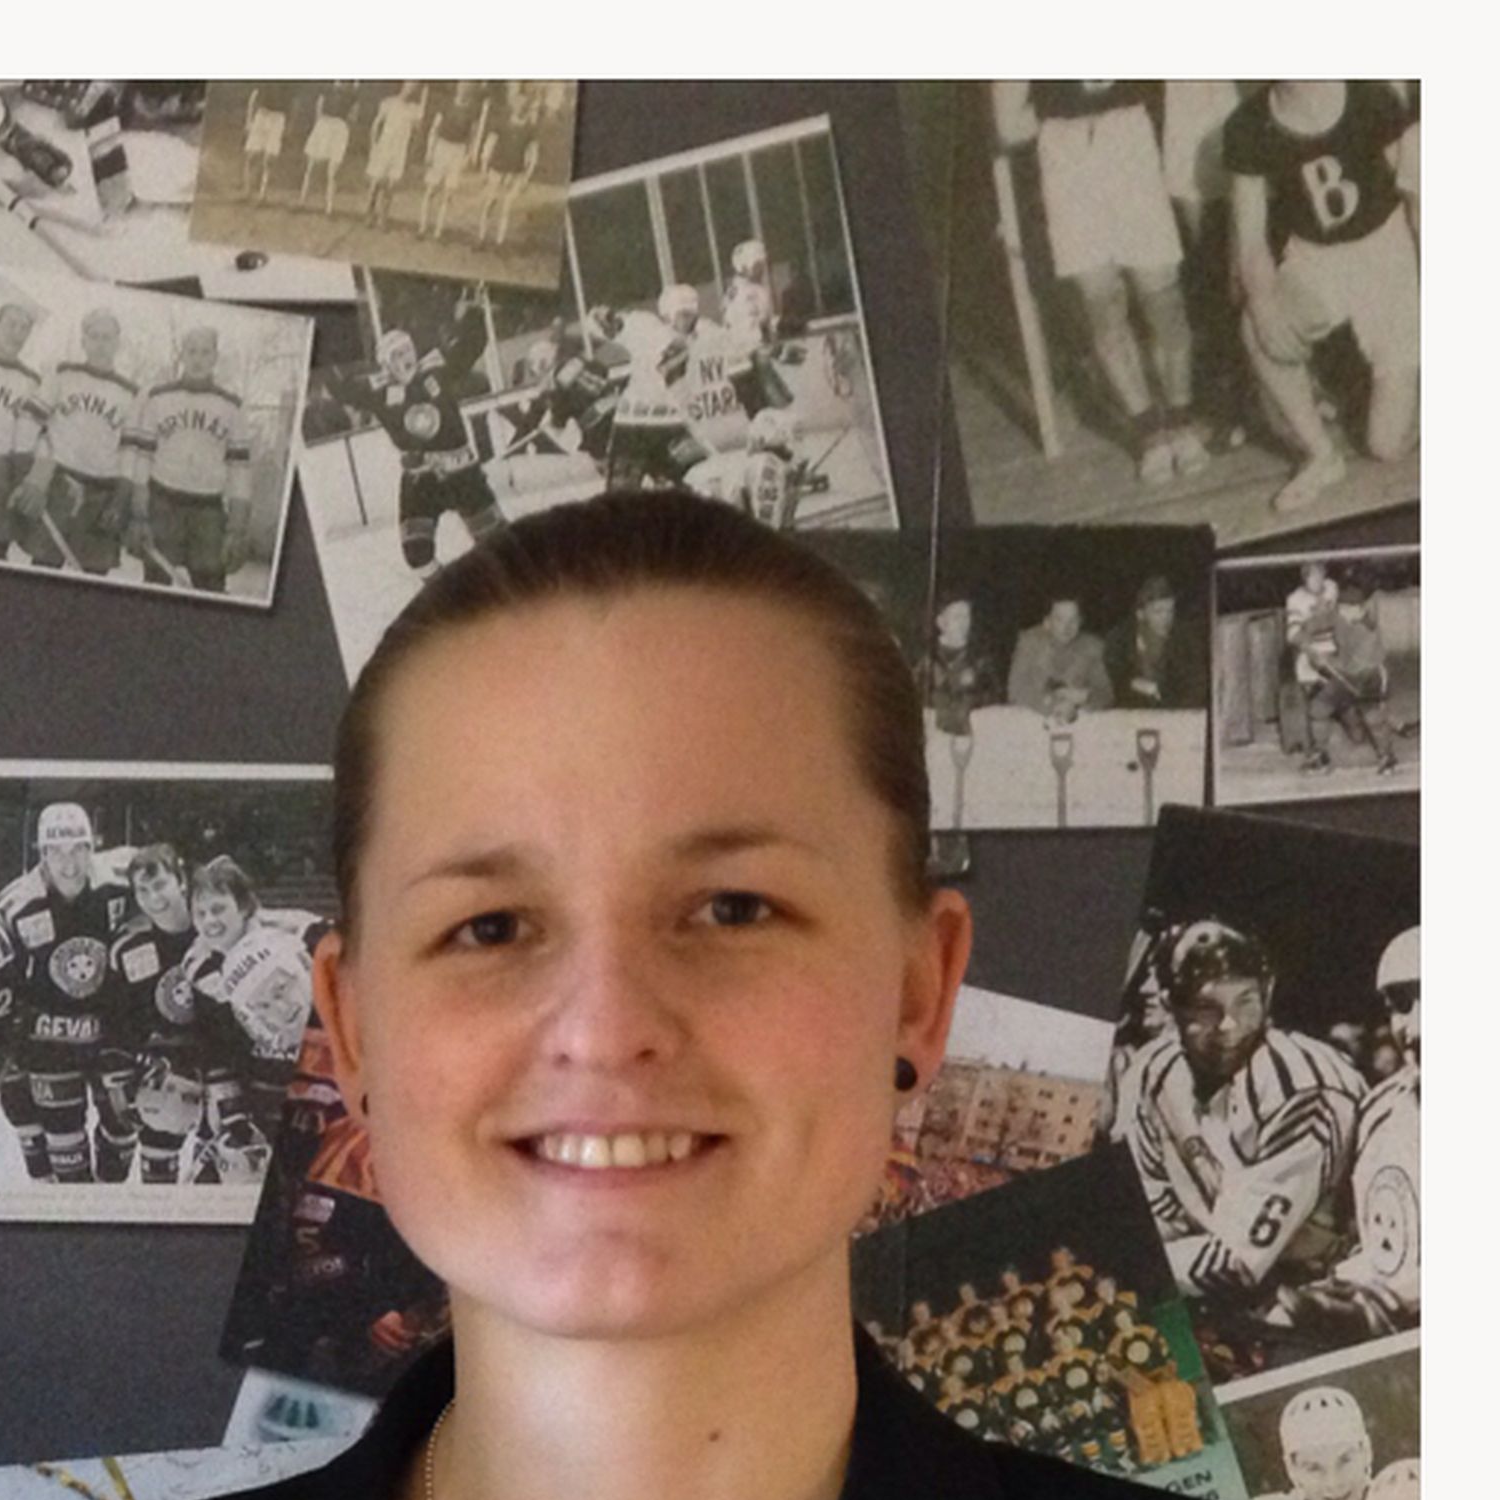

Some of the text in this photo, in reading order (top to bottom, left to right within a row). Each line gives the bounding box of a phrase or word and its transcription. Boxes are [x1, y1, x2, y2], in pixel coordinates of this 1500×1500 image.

[1302, 155, 1359, 231] B
[35, 1014, 100, 1040] GEVA
[1249, 1194, 1293, 1248] 6
